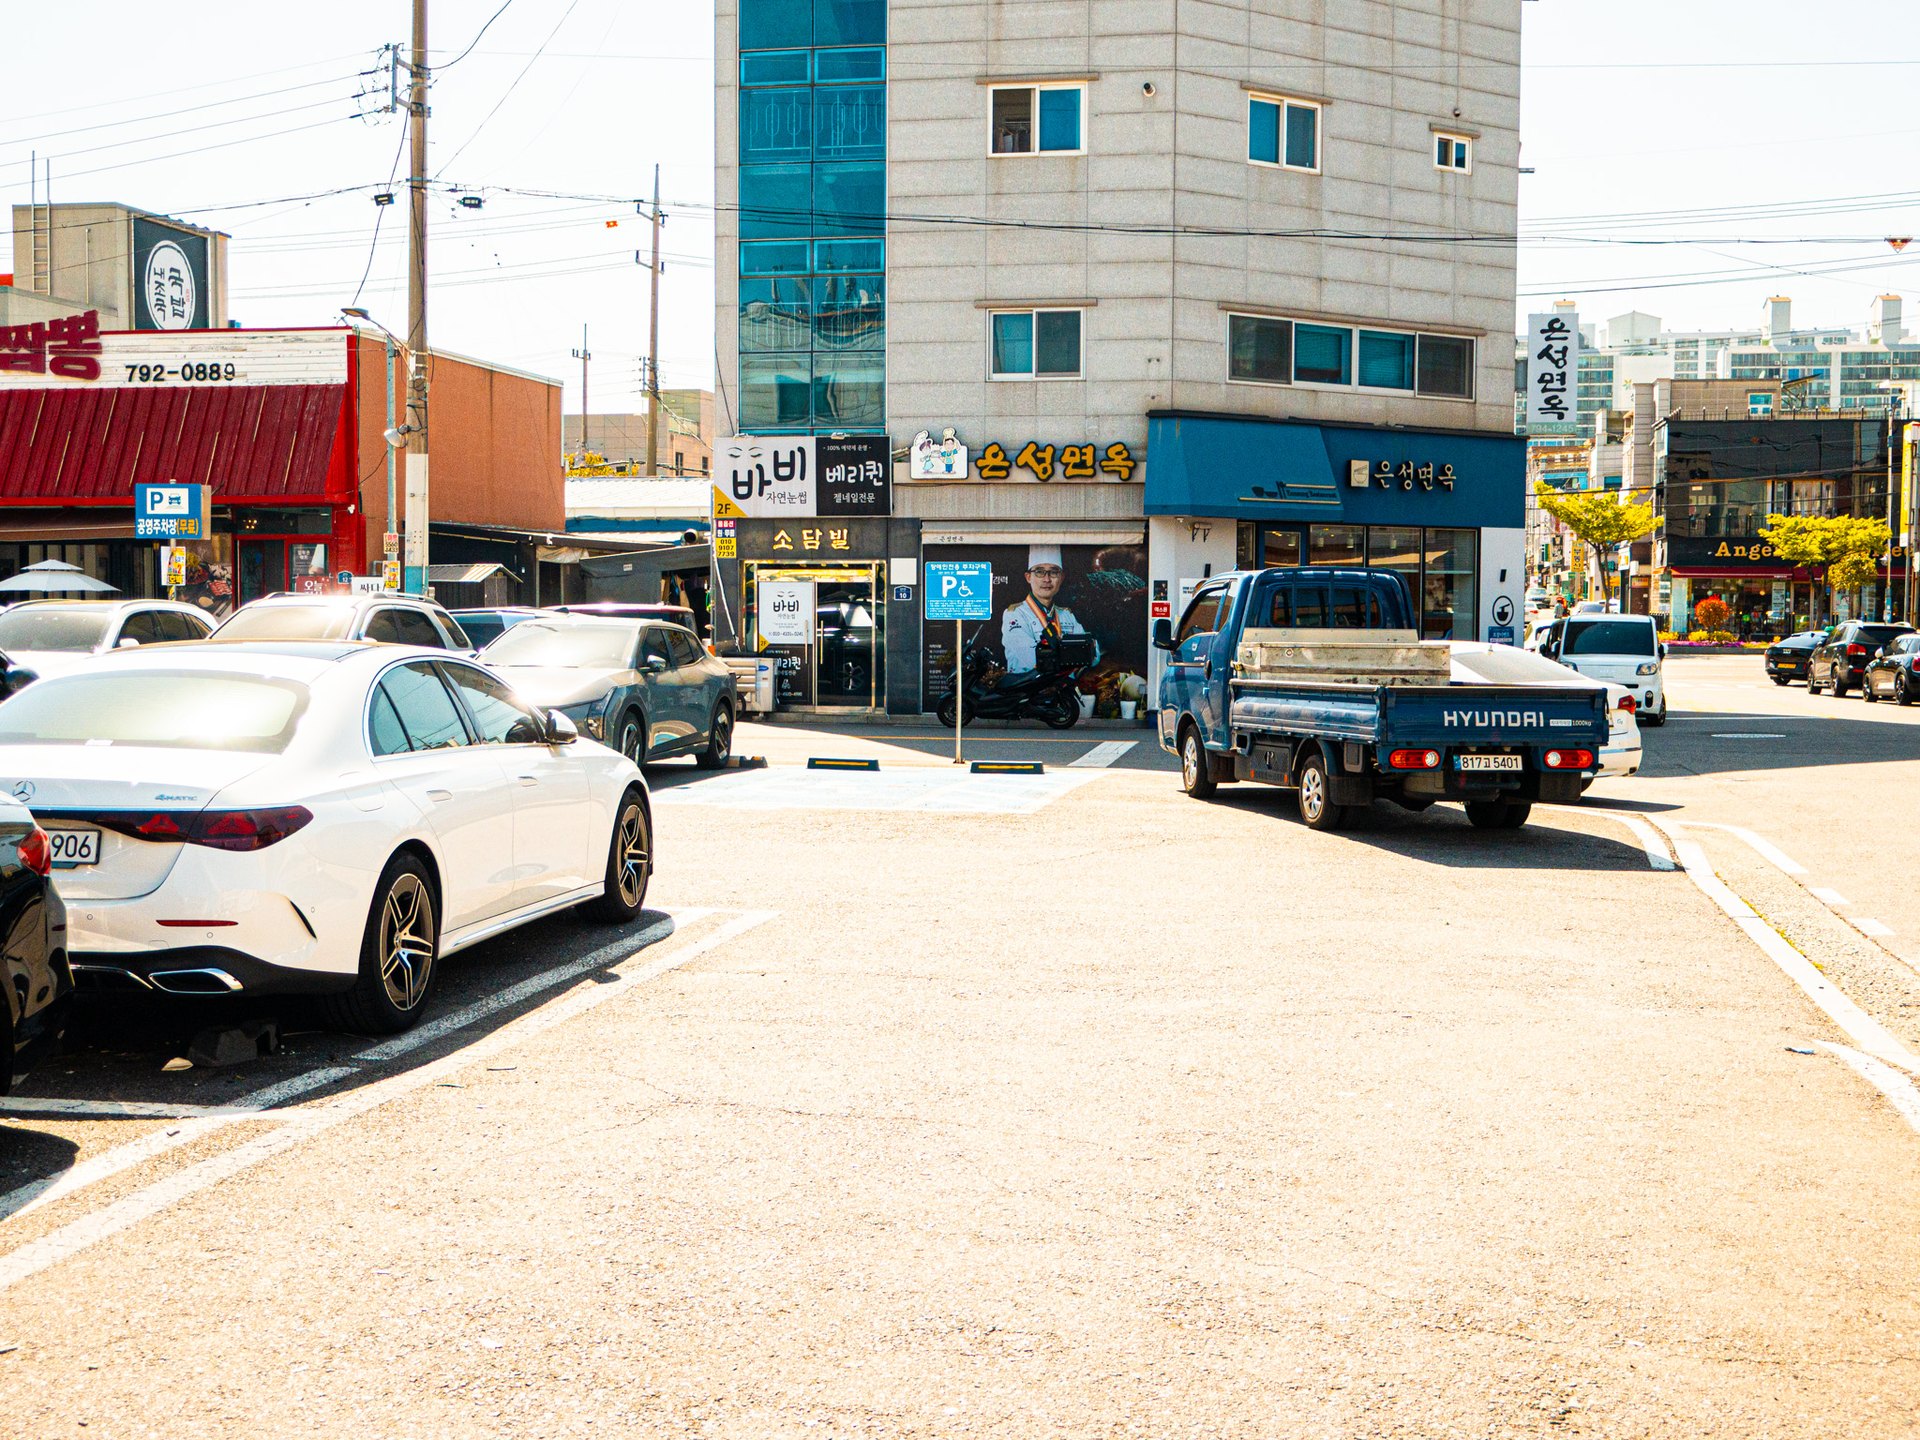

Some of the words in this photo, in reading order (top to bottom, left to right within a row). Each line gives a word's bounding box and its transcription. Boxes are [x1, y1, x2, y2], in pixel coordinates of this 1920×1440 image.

[1537, 317, 1571, 420] 은성면옥
[975, 441, 1137, 481] 은성면옥
[732, 446, 806, 500] 바비
[825, 460, 884, 486] 베리퀸
[1374, 460, 1457, 493] 은성면옥
[150, 491, 164, 511] P
[766, 491, 807, 504] 자연눈썹
[717, 503, 731, 514] 2F
[137, 518, 199, 535] 공영주차장(무료)
[772, 528, 850, 550] 소담빌
[1715, 541, 1781, 560] Ange
[942, 575, 957, 598] P
[773, 600, 800, 612] 바비
[1443, 710, 1545, 727] HYUNDAI
[1493, 757, 1520, 769] 5401
[51, 834, 92, 859] 906
